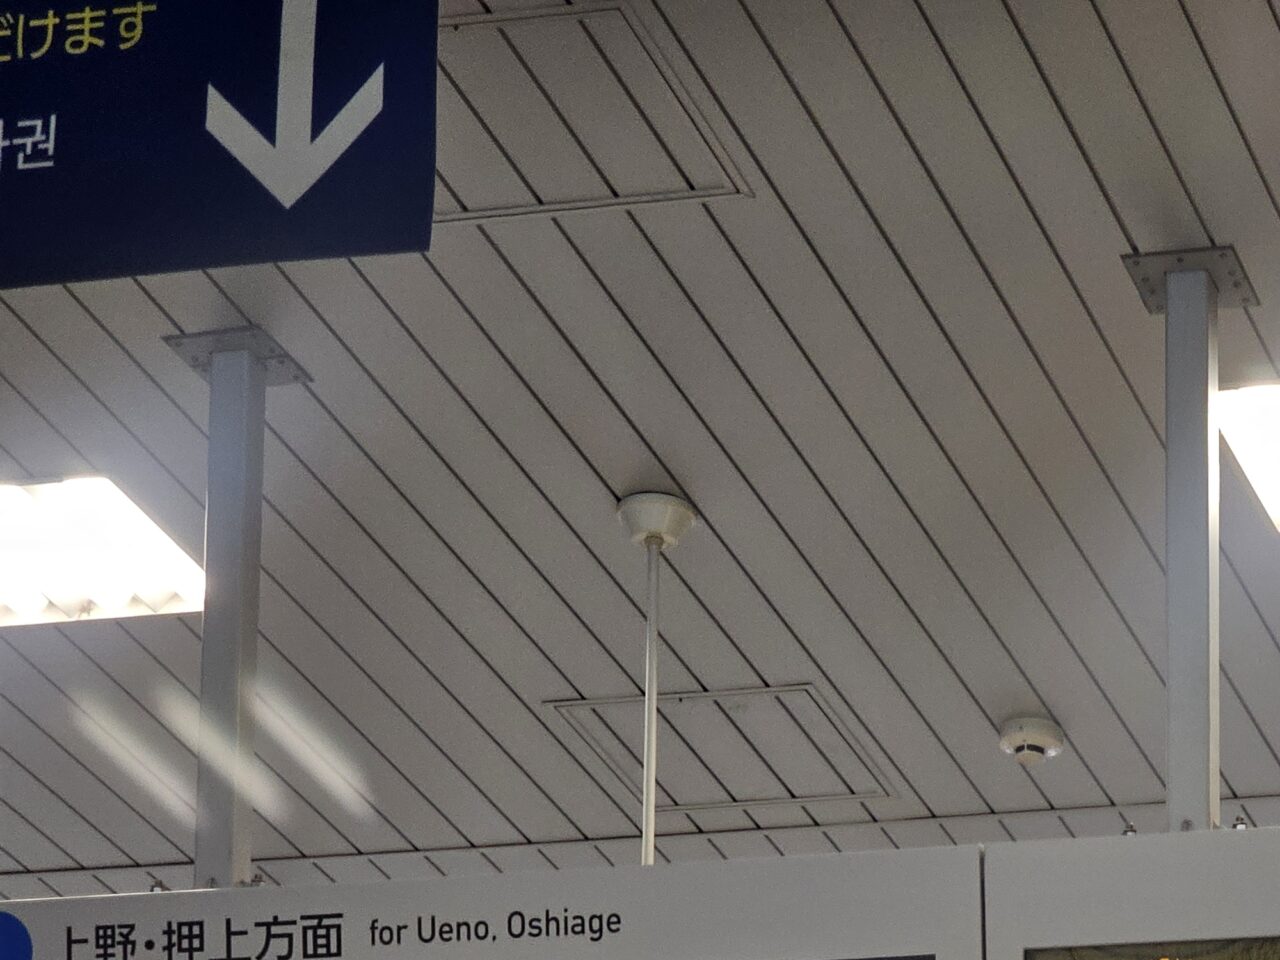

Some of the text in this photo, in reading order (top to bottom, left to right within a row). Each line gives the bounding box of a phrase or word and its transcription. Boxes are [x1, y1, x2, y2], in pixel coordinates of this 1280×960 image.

[370, 908, 622, 946] for Ueno, Oshiage
